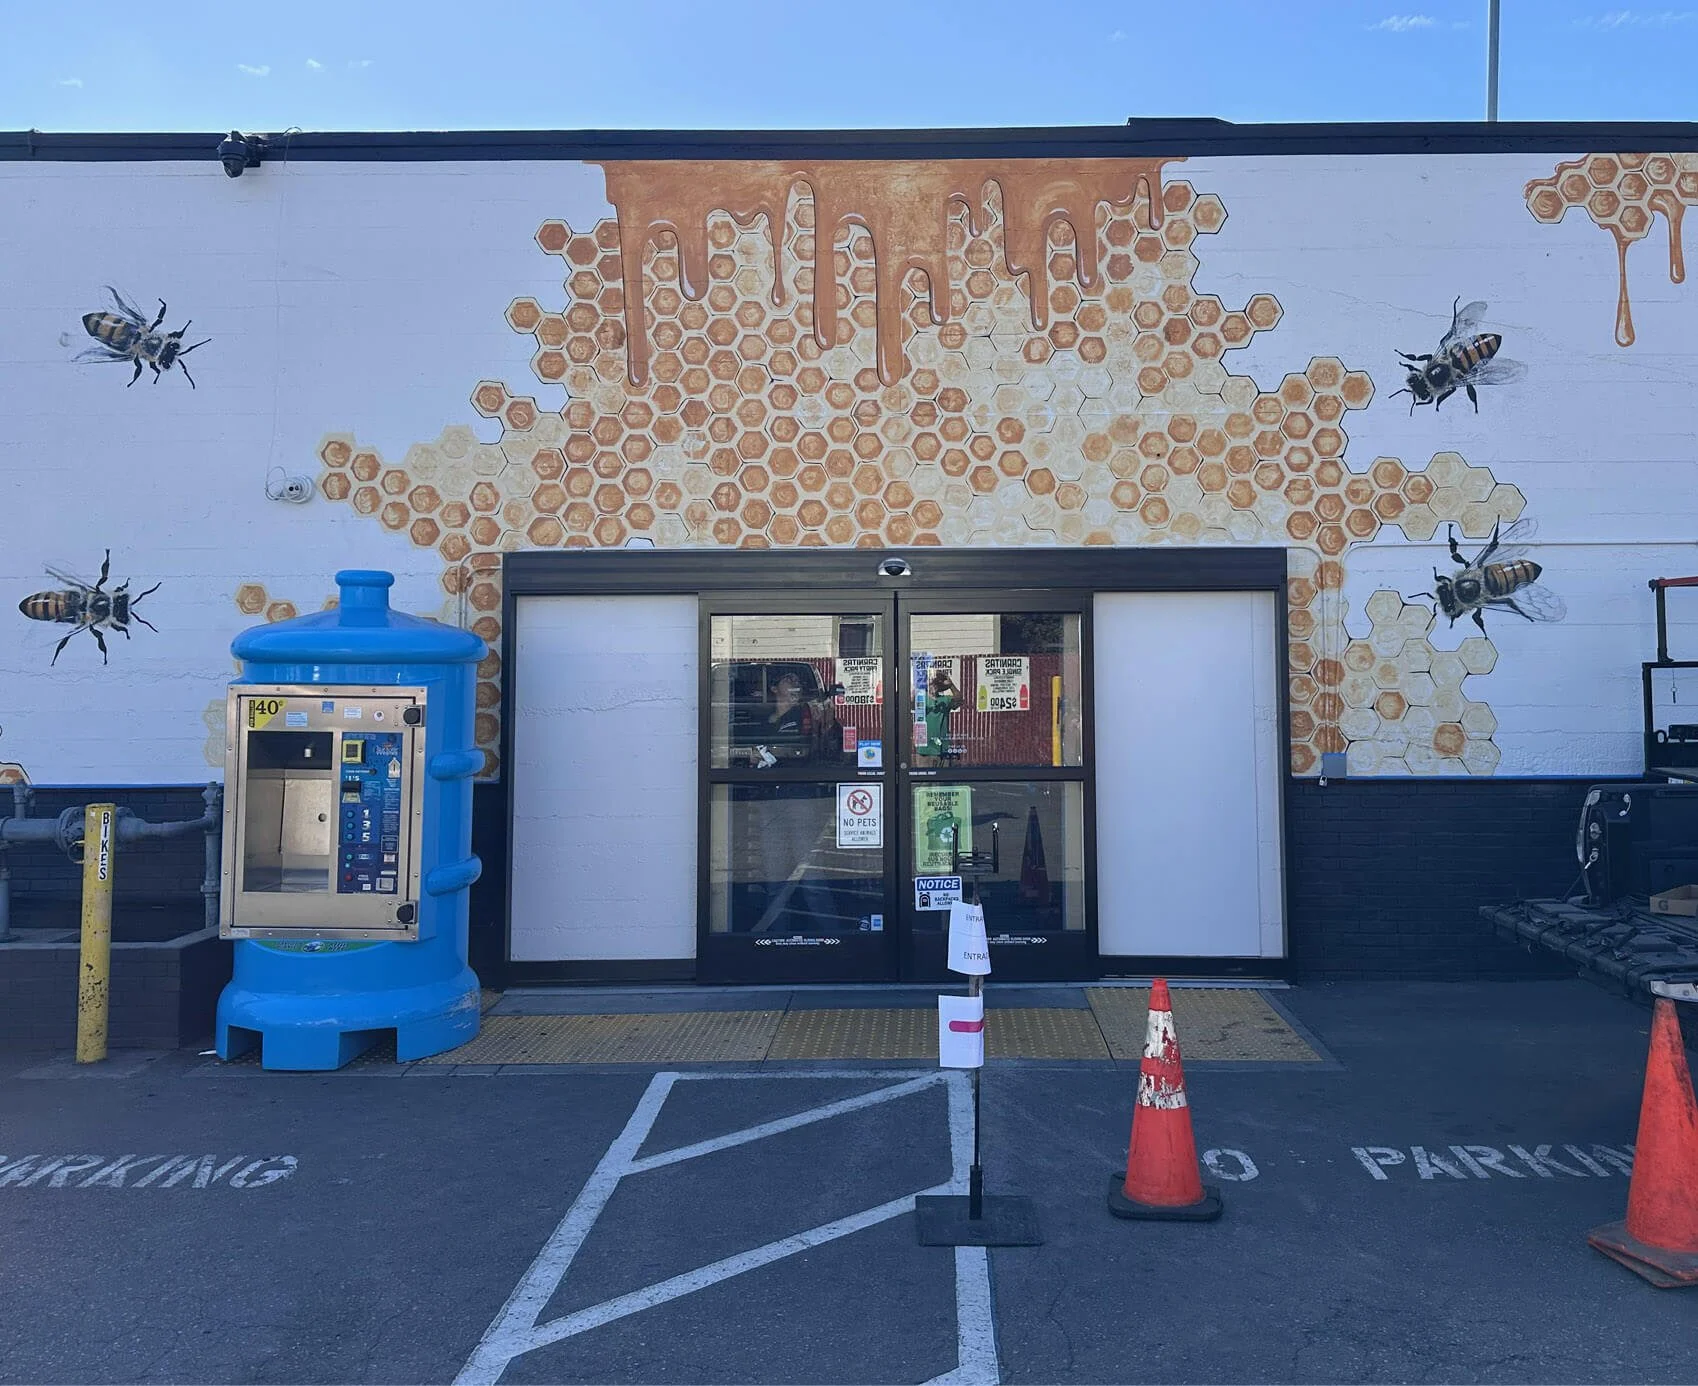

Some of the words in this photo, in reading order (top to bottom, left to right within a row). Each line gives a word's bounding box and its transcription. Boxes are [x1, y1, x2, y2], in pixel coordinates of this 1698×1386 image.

[363, 808, 370, 819] 1
[362, 820, 371, 830] 3
[843, 818, 854, 827] NO
[857, 818, 877, 827] PETS
[362, 832, 371, 841] 5
[99, 812, 110, 880] BIKES
[918, 879, 959, 889] NOTICE
[965, 914, 984, 922] ENTRA
[1201, 1149, 1259, 1181] O
[1351, 1144, 1635, 1180] PARKIN
[0, 1154, 298, 1188] ARKING
